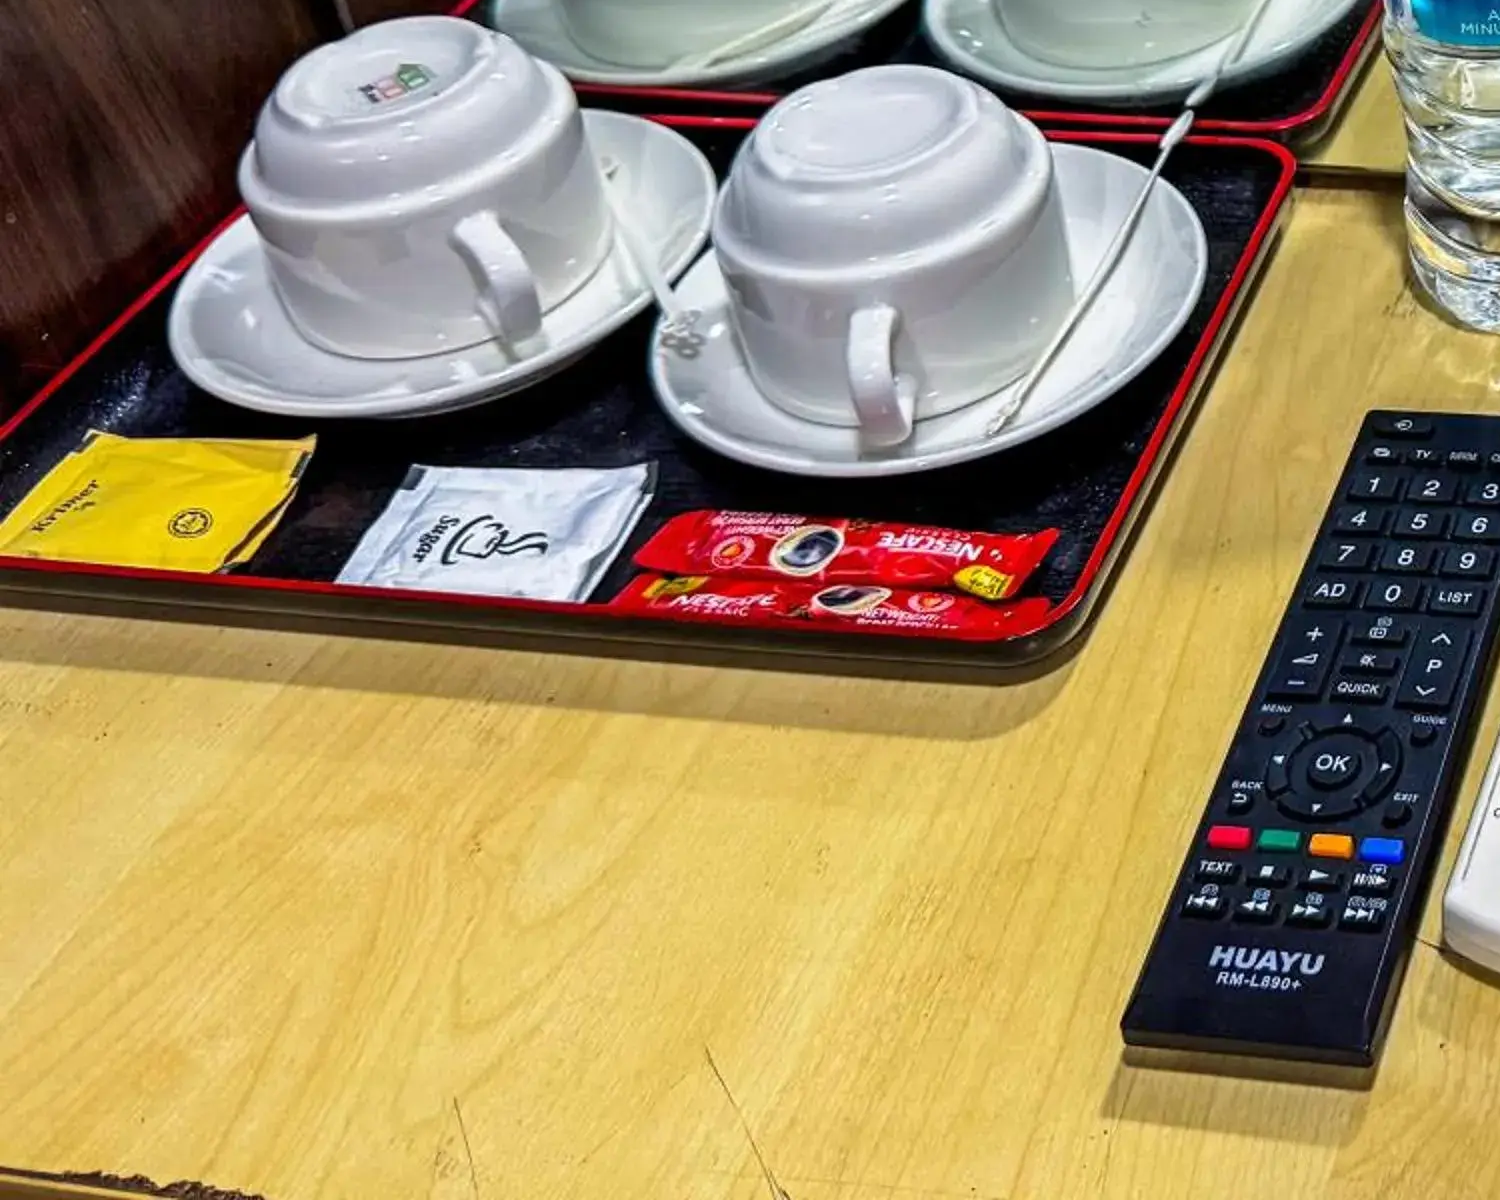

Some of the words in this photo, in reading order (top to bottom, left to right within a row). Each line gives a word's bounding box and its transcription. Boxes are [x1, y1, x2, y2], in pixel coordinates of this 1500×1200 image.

[1369, 477, 1381, 493] 1
[1422, 480, 1440, 496] 2
[1482, 484, 1499, 499] 3
[1351, 511, 1367, 527] 4
[1411, 514, 1428, 530] 5
[1471, 518, 1488, 533] 6
[412, 514, 461, 563] Sugar
[1338, 545, 1356, 561] 7
[1398, 549, 1415, 565] 8
[1459, 553, 1476, 569] 9
[1314, 583, 1346, 598] AD
[1385, 585, 1401, 601] 0
[1438, 590, 1473, 604] LIST
[1427, 658, 1443, 673] P
[1337, 681, 1380, 696] QUICK
[1261, 703, 1293, 714] MENU
[1413, 714, 1448, 726] GUIDE
[1315, 754, 1352, 772] OK
[1231, 780, 1264, 791] BACK
[1393, 792, 1420, 803] EXIT
[1199, 860, 1233, 873] TEXT
[1208, 945, 1326, 975] HUAYU
